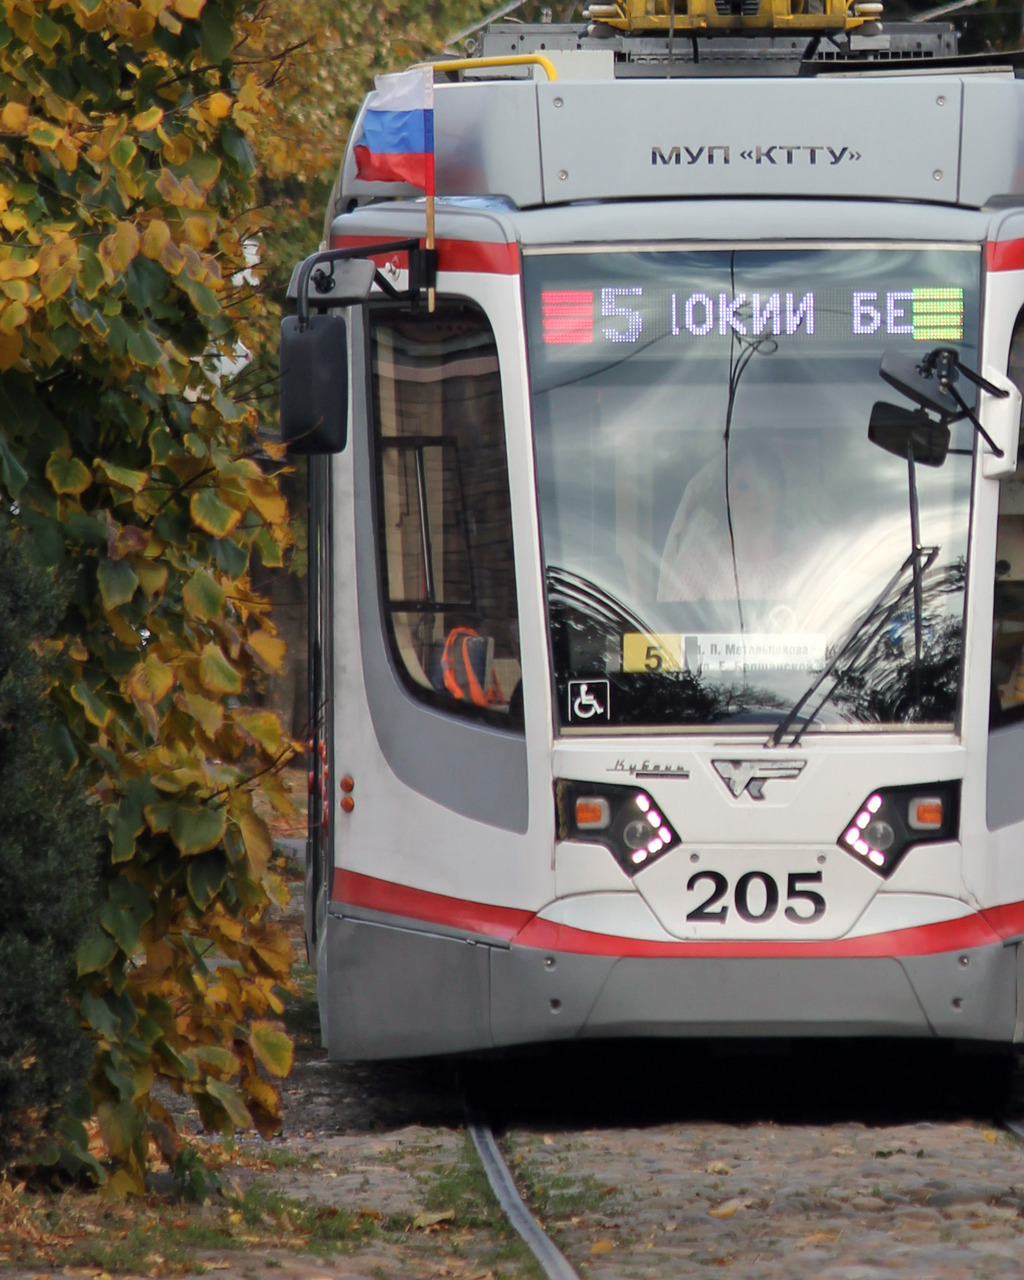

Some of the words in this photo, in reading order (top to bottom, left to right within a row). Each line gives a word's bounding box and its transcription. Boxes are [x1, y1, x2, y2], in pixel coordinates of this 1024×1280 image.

[651, 146, 730, 165] МУП
[739, 146, 862, 165] «КТТУ»
[601, 287, 643, 343] 5
[671, 292, 814, 336] ОКИИ
[644, 646, 663, 671] 5
[686, 870, 827, 925] 205
